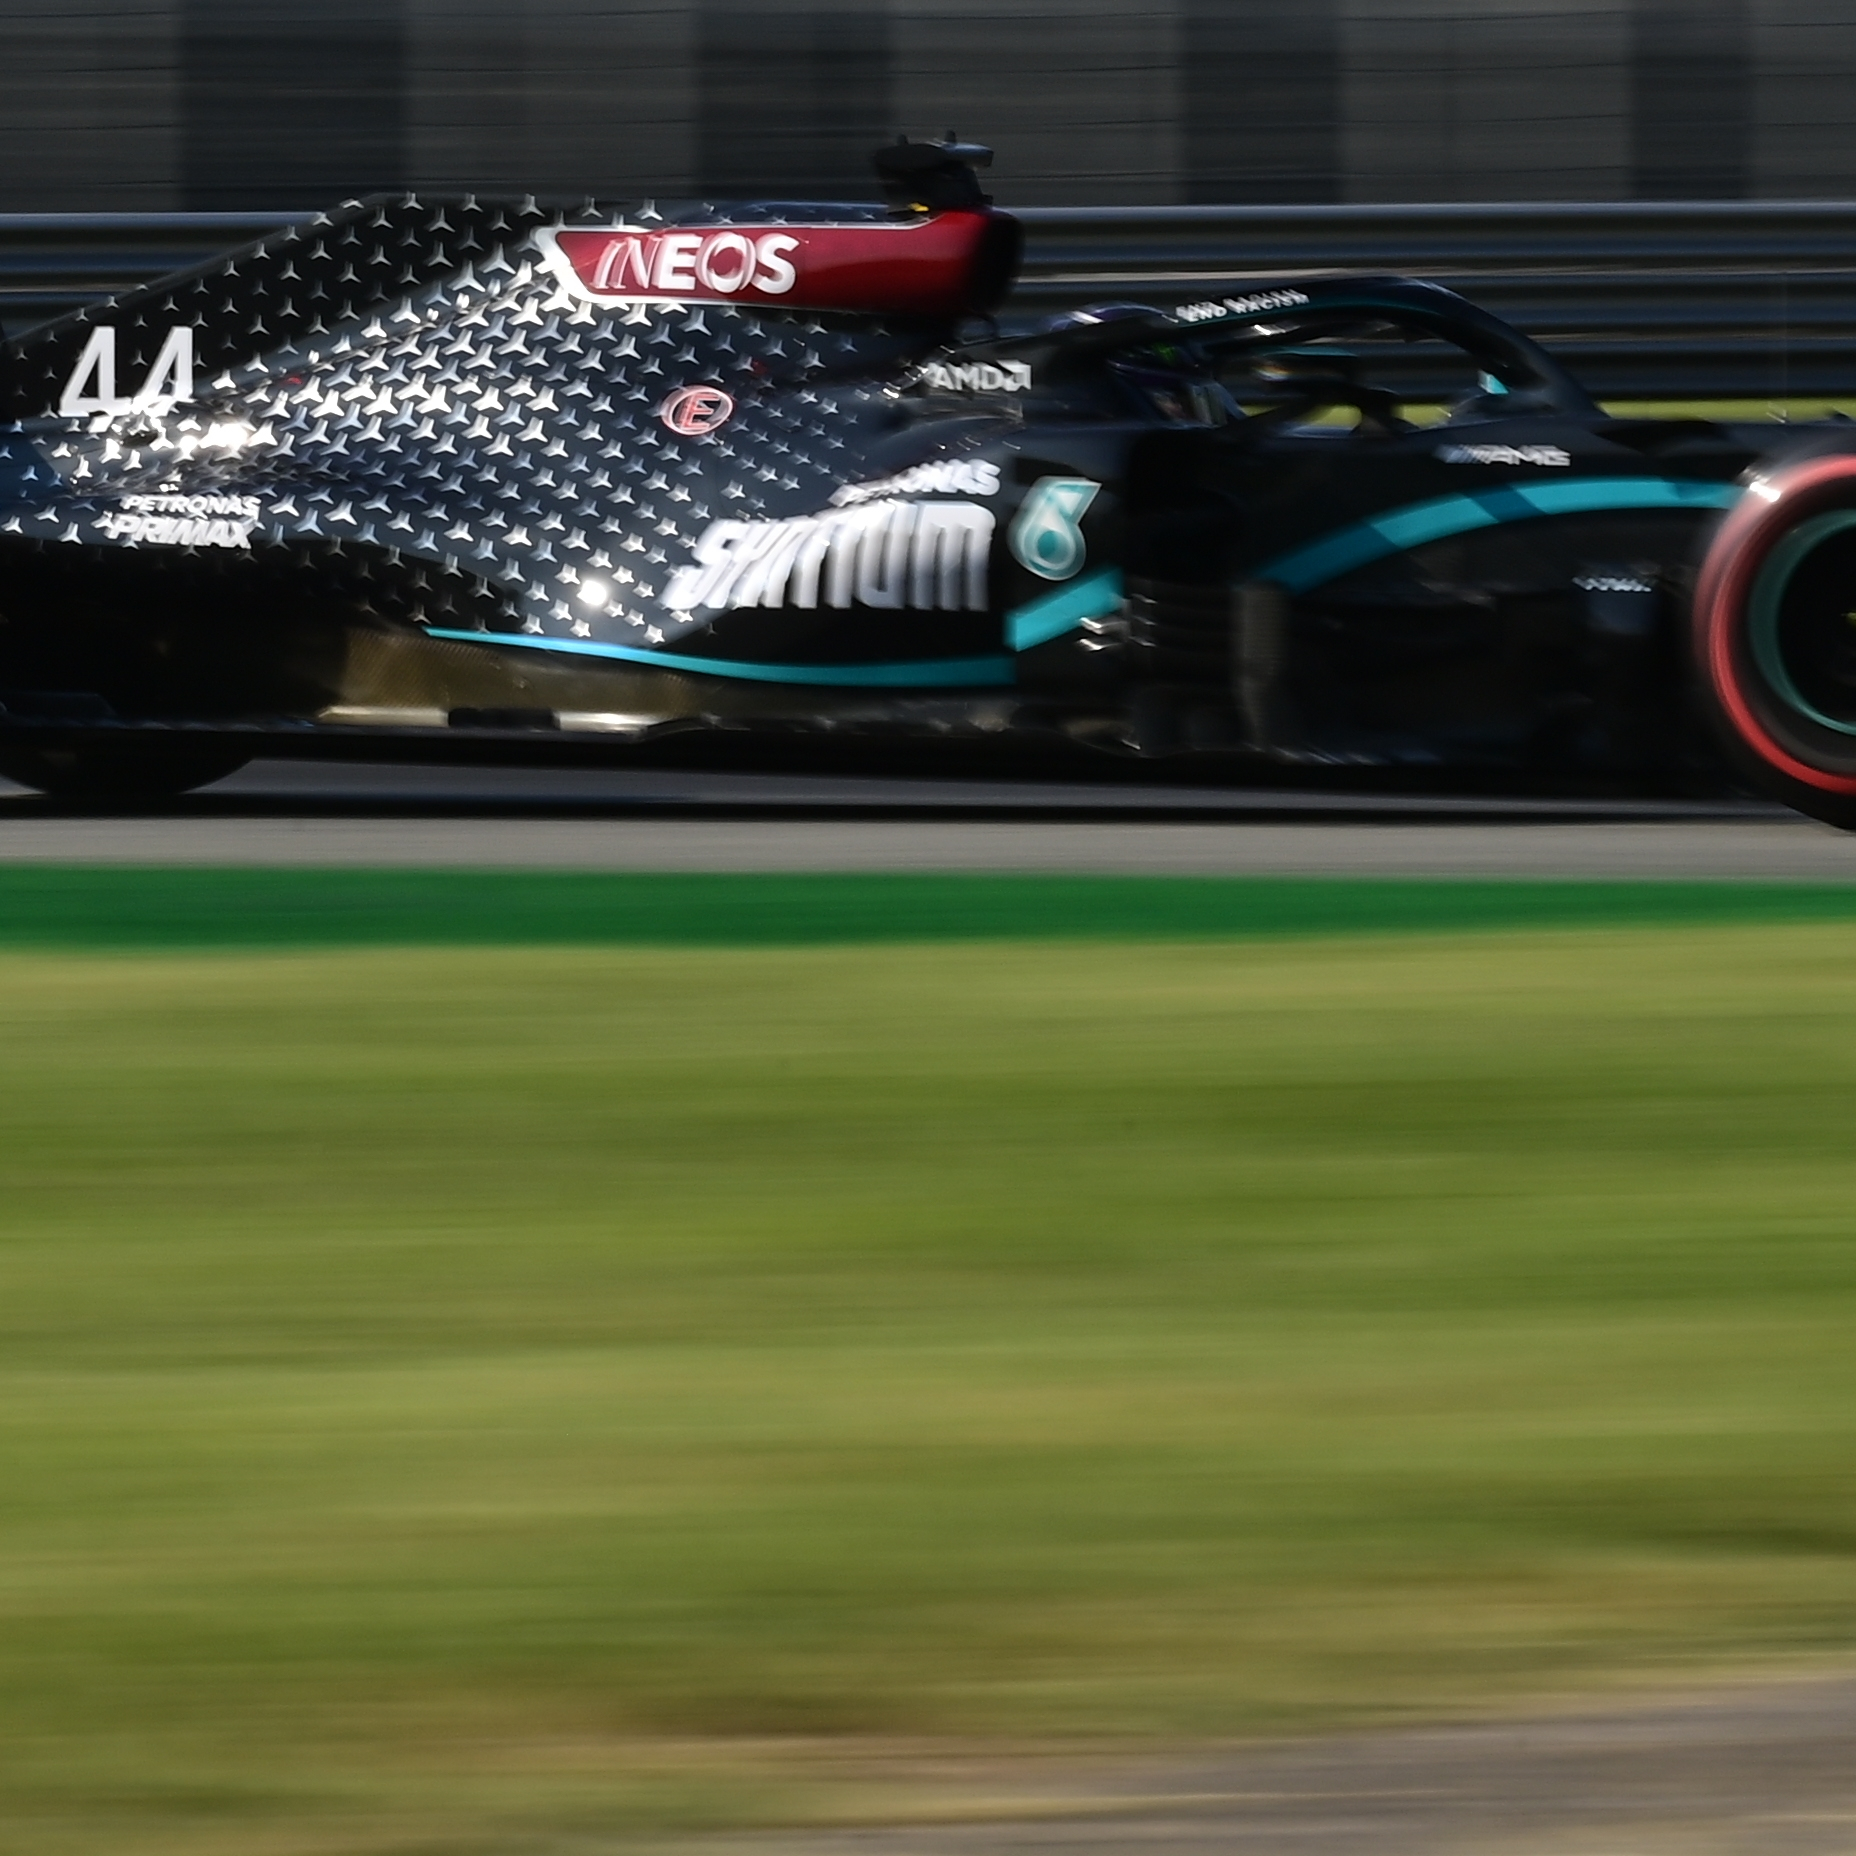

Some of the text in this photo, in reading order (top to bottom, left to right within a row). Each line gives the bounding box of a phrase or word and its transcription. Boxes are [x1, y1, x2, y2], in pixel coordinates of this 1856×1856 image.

[591, 231, 799, 294] INEOS
[59, 325, 194, 417] 44
[119, 495, 262, 515] PETRONAS
